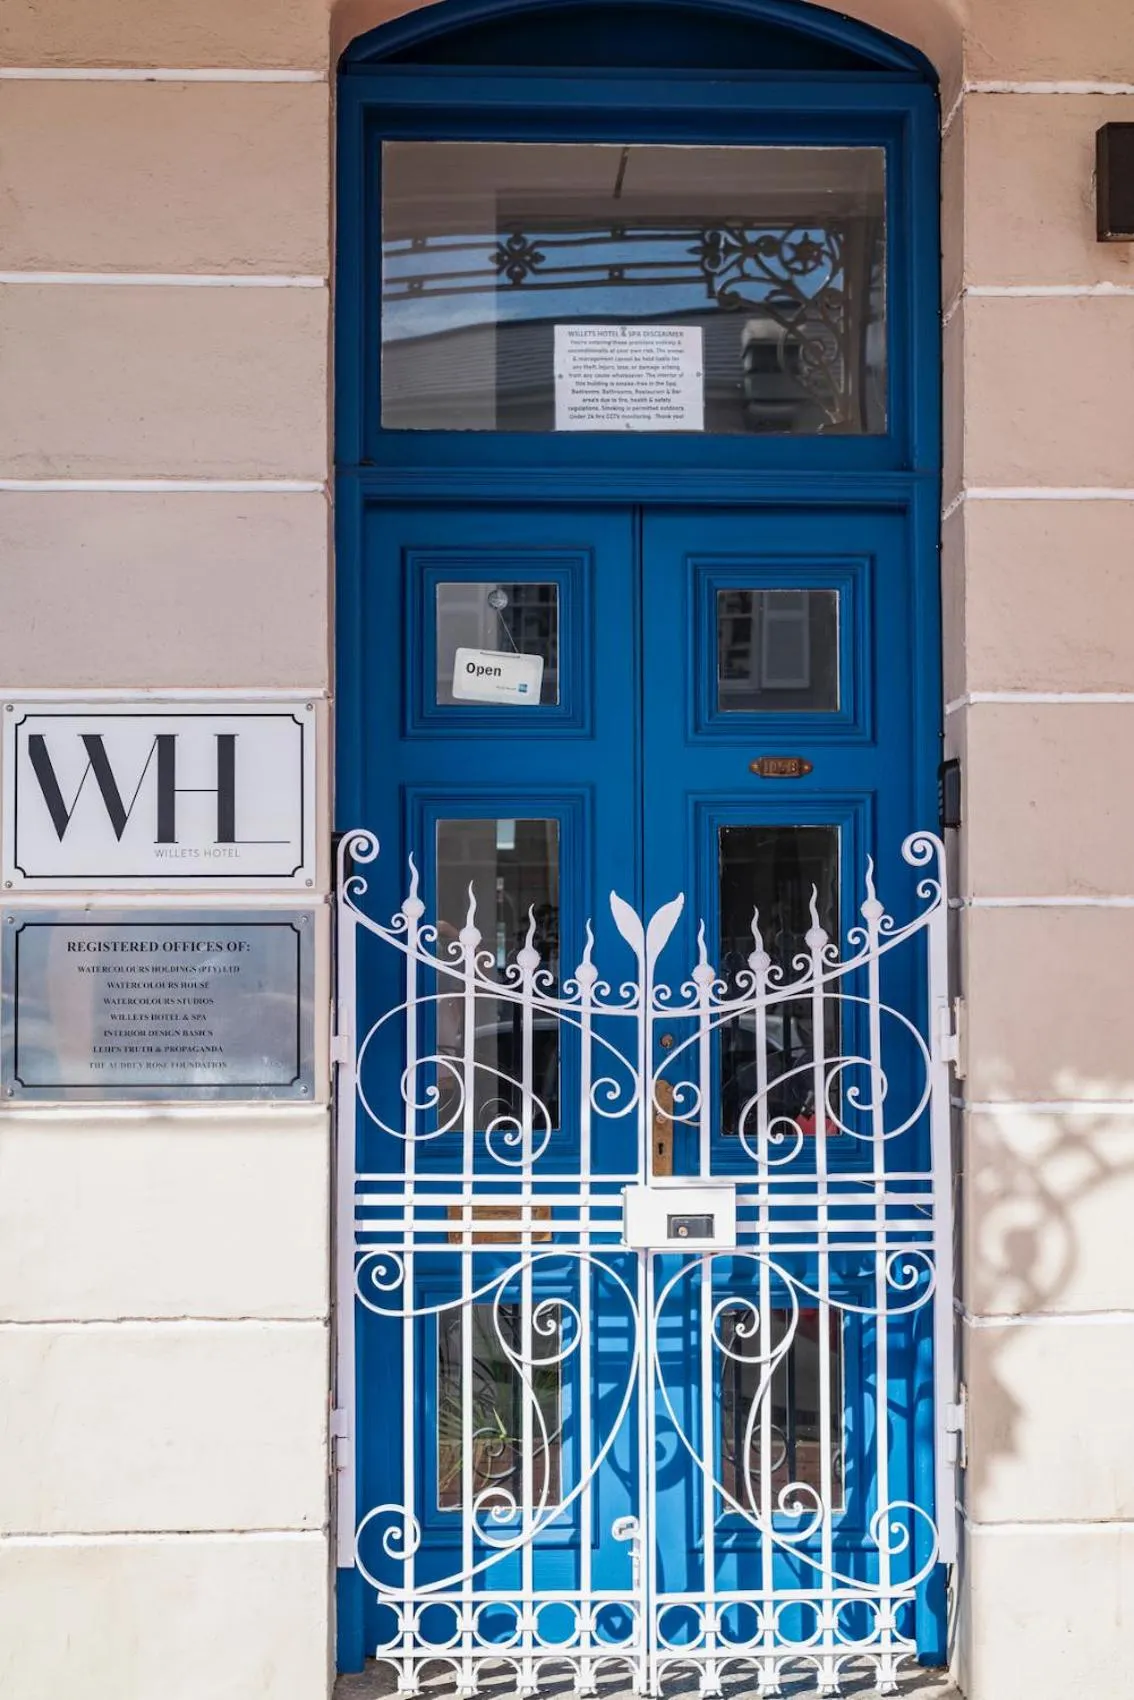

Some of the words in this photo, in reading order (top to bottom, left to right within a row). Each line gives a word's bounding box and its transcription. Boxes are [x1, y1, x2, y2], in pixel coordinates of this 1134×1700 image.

[466, 662, 502, 677] Open
[154, 849, 200, 858] WILLETS
[204, 849, 240, 858] HOTEL
[67, 941, 159, 952] REGISTERED
[162, 941, 224, 952] OFFICES
[226, 941, 251, 952] OF:
[110, 1013, 149, 1021] WILLETS
[151, 1013, 181, 1021] HOTEL
[182, 1013, 189, 1021] &
[192, 1013, 207, 1021] SPA
[103, 1029, 147, 1037] INTERIOR
[148, 1029, 181, 1037] DESIGN
[182, 1029, 214, 1037] BASICS
[124, 1045, 153, 1053] TRUTH
[154, 1045, 162, 1053] &
[164, 1045, 224, 1053] PROPAGANDA
[90, 1061, 105, 1069] THE
[146, 1061, 168, 1069] ROSE
[171, 1061, 227, 1069] FOUNDATION
